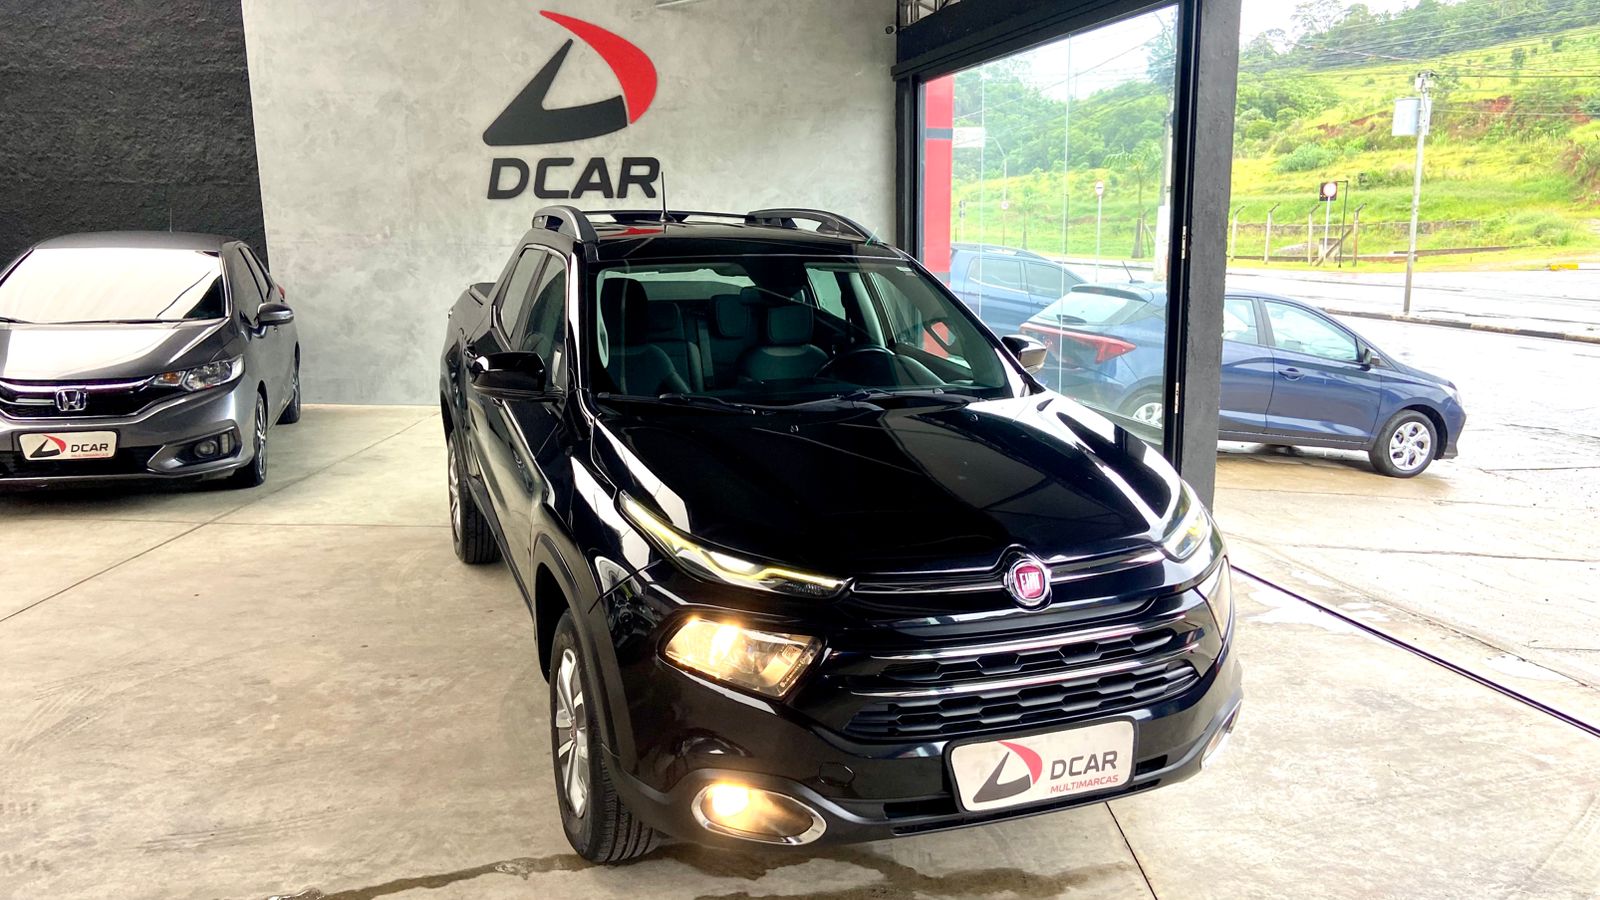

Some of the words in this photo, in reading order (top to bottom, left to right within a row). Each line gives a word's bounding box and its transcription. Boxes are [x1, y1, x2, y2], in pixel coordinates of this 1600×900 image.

[487, 157, 660, 199] DCAR
[70, 443, 109, 453] DCAR
[1050, 750, 1118, 780] DCAR
[1050, 774, 1119, 793] MULTIMARCAS
